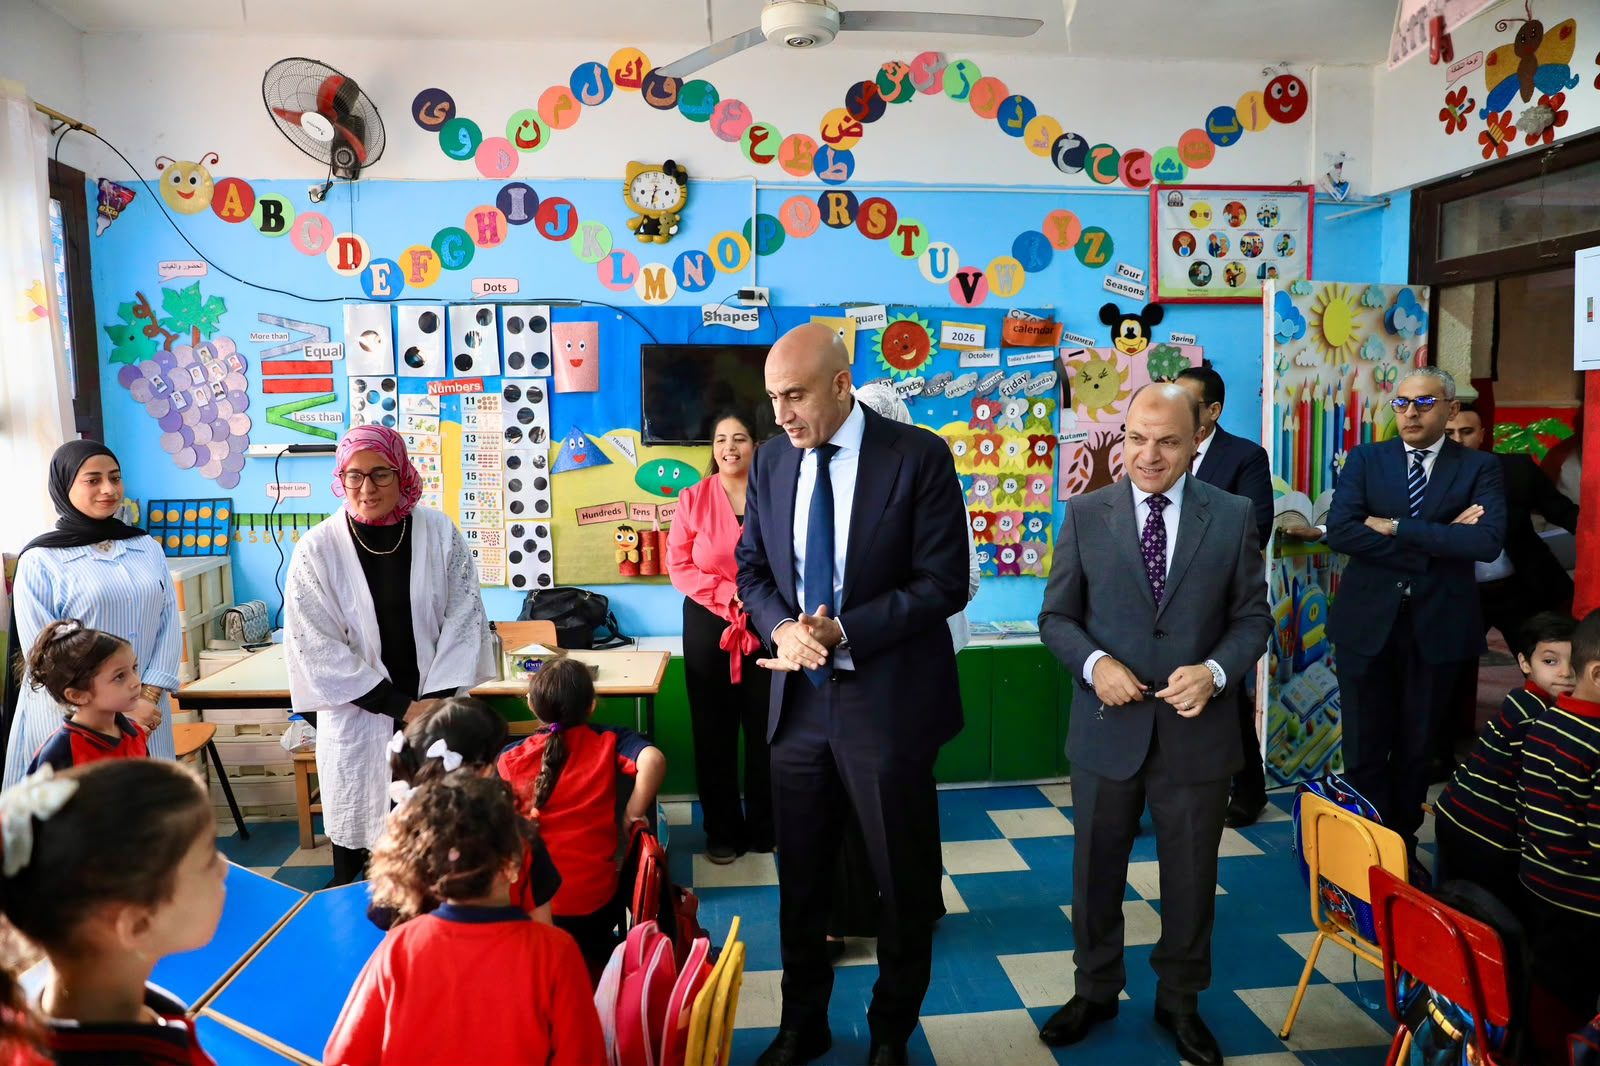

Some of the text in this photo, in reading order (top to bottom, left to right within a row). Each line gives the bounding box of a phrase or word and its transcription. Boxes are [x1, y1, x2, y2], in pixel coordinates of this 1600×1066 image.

[614, 56, 644, 88] ك
[909, 52, 949, 92] س
[581, 64, 605, 106] ل
[876, 60, 910, 102] ش
[951, 62, 970, 99] ز
[678, 84, 714, 115] ف
[848, 80, 878, 122] ص
[977, 84, 995, 112] ر
[553, 94, 573, 127] م
[1007, 95, 1024, 129] ذ
[716, 99, 744, 142] غ
[515, 119, 541, 149] ن
[821, 115, 863, 144] ض
[1209, 116, 1239, 144] ب
[450, 127, 472, 156] و
[749, 125, 775, 164] ع
[1033, 126, 1049, 150] د
[785, 137, 813, 171] ظ
[1057, 132, 1081, 174] خ
[1183, 141, 1211, 161] ت
[820, 147, 848, 181] ط
[1092, 147, 1118, 184] ح
[1123, 151, 1150, 187] ج
[1154, 157, 1184, 181] ث
[221, 183, 245, 218] A
[259, 199, 285, 233] B
[300, 216, 323, 250] C
[337, 237, 363, 270] D
[369, 263, 392, 296] E
[409, 250, 433, 283] F
[441, 234, 466, 267] G
[474, 211, 500, 245] H
[507, 187, 528, 221] I
[545, 203, 571, 237] J
[582, 224, 606, 258] K
[610, 252, 634, 285] L
[643, 267, 668, 300] M
[683, 254, 706, 288] N
[717, 237, 741, 269] O
[756, 219, 777, 253] P
[789, 200, 814, 232] Q
[827, 192, 851, 225] R
[866, 202, 888, 235] S
[897, 224, 920, 256] T
[928, 247, 950, 279] U
[956, 272, 983, 304] V
[994, 264, 1018, 294] W
[1052, 215, 1072, 246] Y
[1083, 232, 1105, 264] Z
[1117, 264, 1141, 280] Four
[483, 282, 507, 292] Dots
[1105, 278, 1145, 296] Seasons
[703, 310, 759, 324] Shapes
[271, 332, 288, 340] than
[1013, 324, 1055, 335] calendar
[951, 332, 976, 343] 2026
[1064, 333, 1094, 346] SUMMER
[1171, 334, 1194, 344] Spring
[304, 344, 343, 359] Equal
[968, 352, 994, 360] October
[428, 381, 482, 395] Numbers
[1001, 373, 1028, 396] Friday
[1027, 375, 1053, 391] Saturday
[465, 397, 476, 405] 11
[294, 412, 342, 422] Less than
[1037, 407, 1042, 415] 3
[407, 417, 413, 425] 2
[465, 416, 477, 424] 12
[408, 436, 414, 444] 3
[464, 434, 476, 443] 13
[612, 437, 635, 458] TRIANGLE
[984, 444, 989, 452] 8
[1037, 444, 1046, 452] 10
[464, 453, 476, 462] 14
[465, 472, 477, 480] 15
[464, 493, 475, 501] 16
[465, 512, 476, 520] 17
[582, 508, 622, 520] Hundreds
[632, 508, 650, 516] Tens
[661, 508, 676, 517] On
[234, 529, 299, 544] 4 5 6 7 8
[466, 531, 478, 539] 18
[472, 549, 478, 558] 9
[641, 546, 654, 561] T
[977, 553, 988, 561] 29
